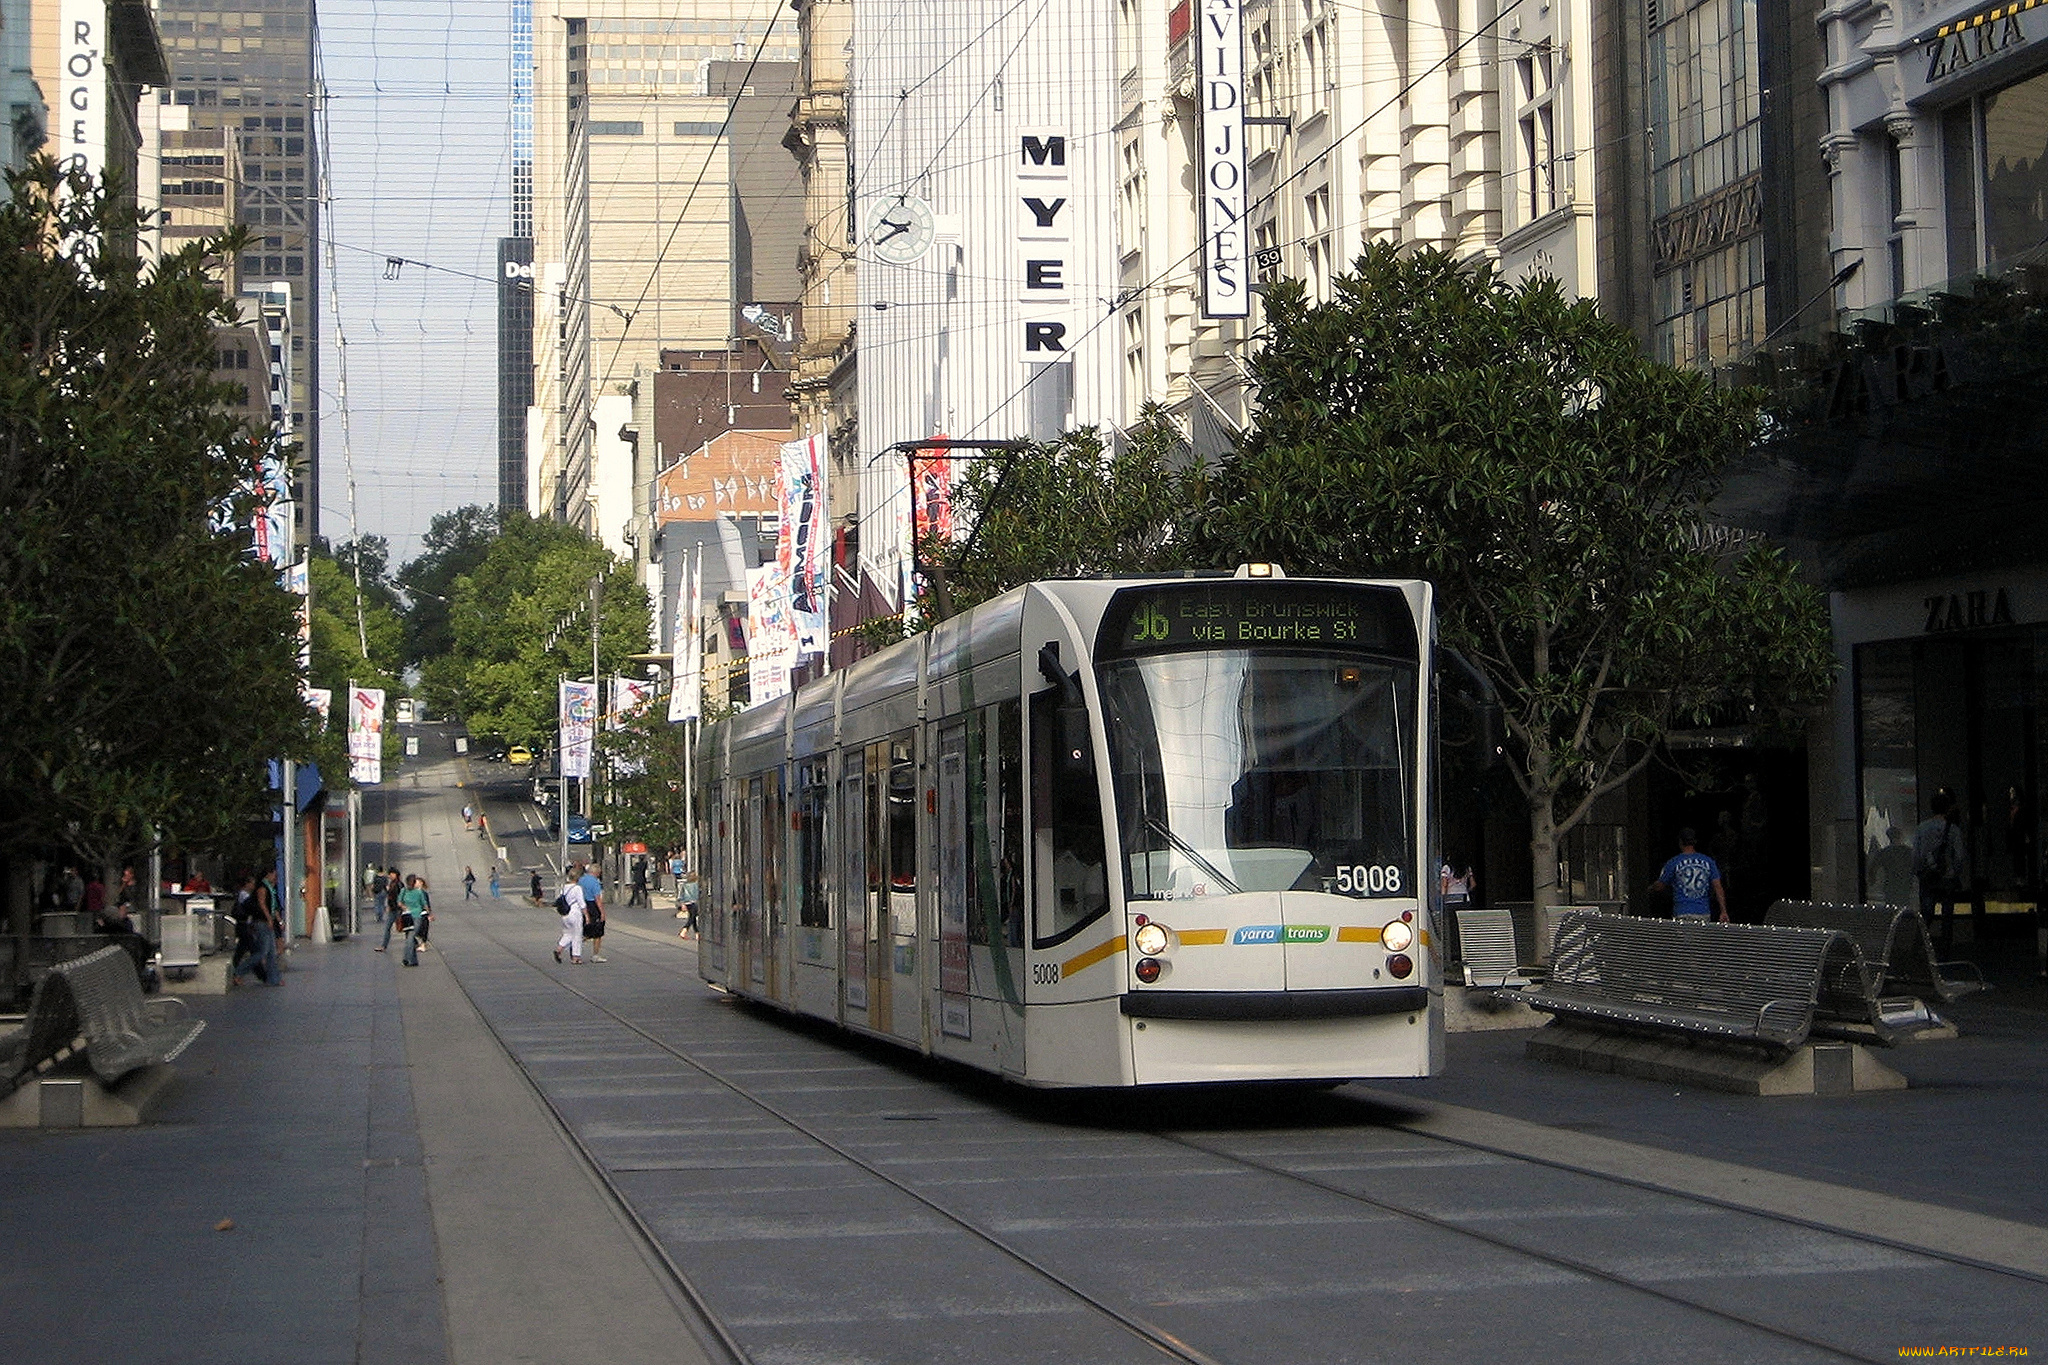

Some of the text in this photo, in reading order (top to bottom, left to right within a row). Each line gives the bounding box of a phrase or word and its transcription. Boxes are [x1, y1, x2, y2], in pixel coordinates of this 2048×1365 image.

[1925, 14, 2027, 83] ZARA
[1210, 125, 1238, 297] JONES
[1021, 136, 1067, 352] MYER
[1259, 250, 1280, 267] 39
[1181, 600, 1359, 618] East Brunswick
[1924, 587, 2016, 632] ZARA
[1192, 621, 1357, 640] via Bourke St
[1336, 865, 1401, 893] 5008
[1240, 928, 1324, 942] yarra trams
[1033, 963, 1059, 984] 5008
